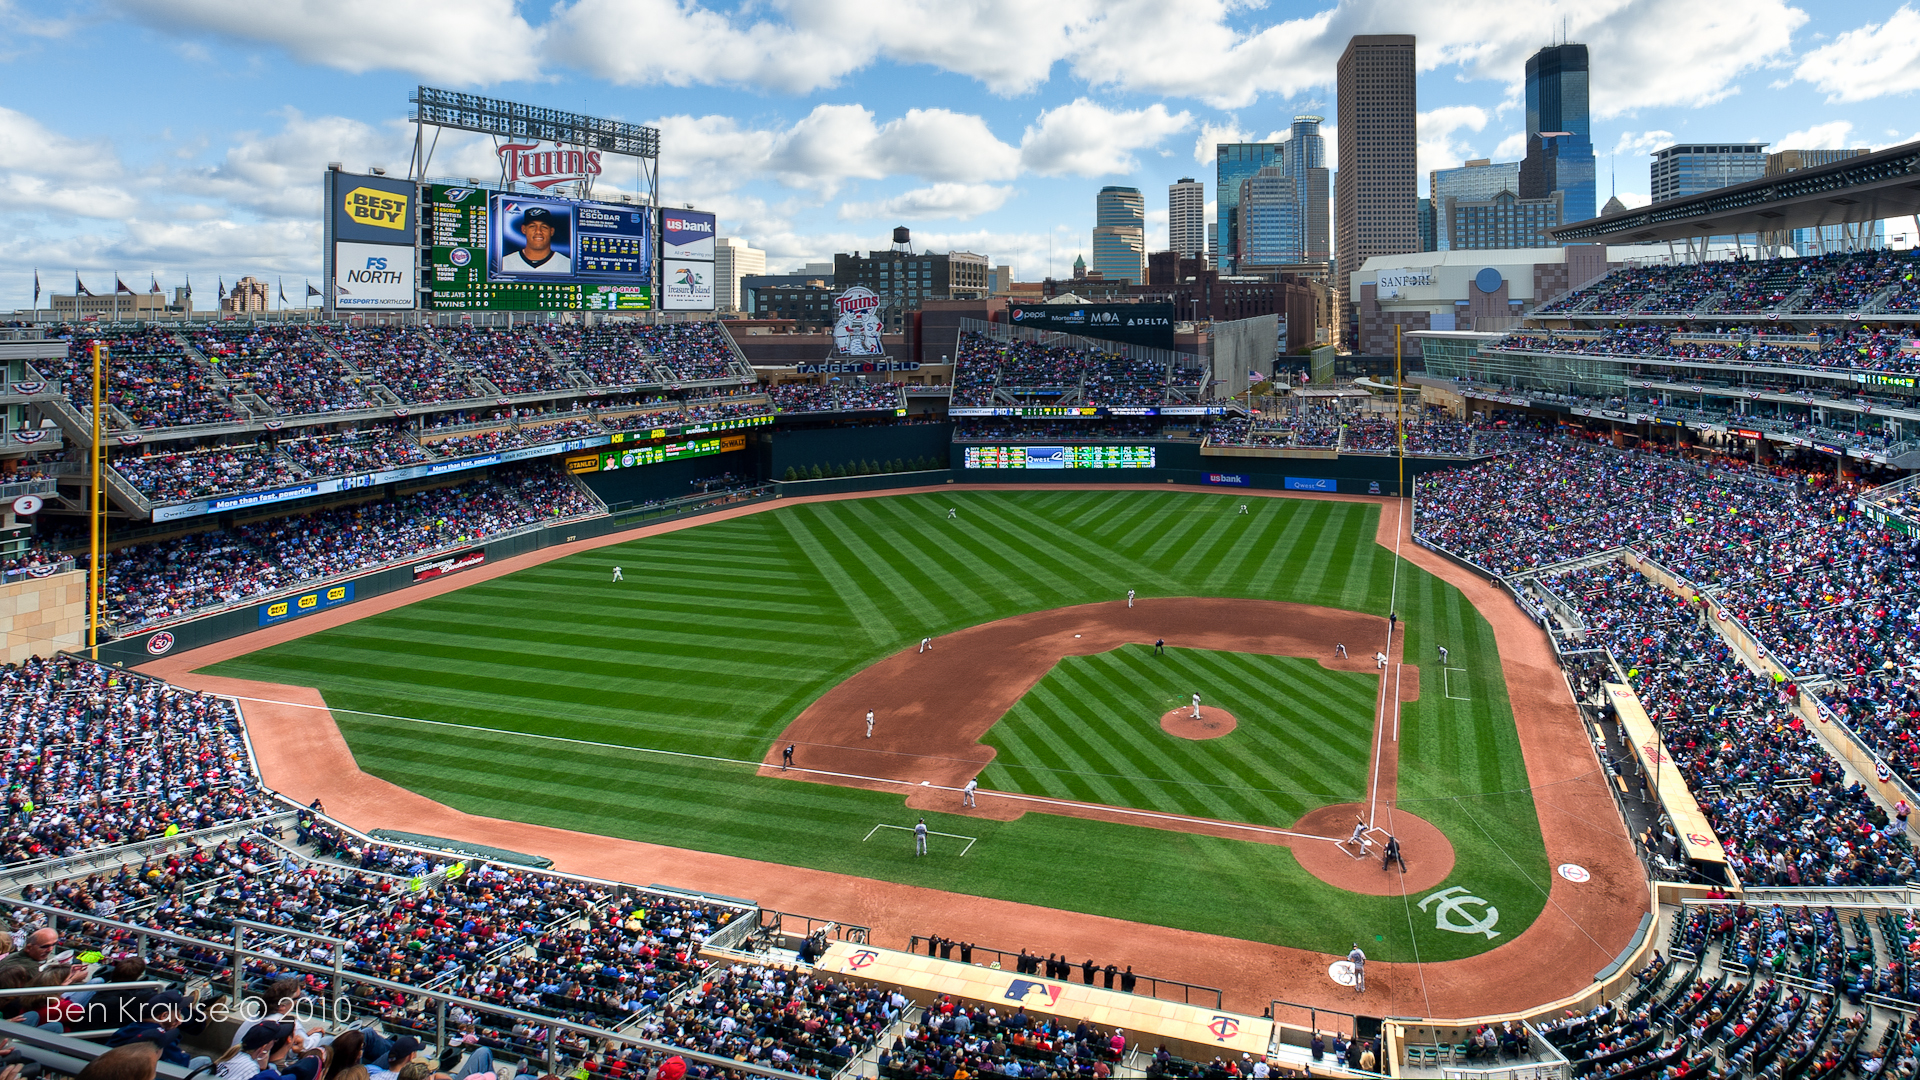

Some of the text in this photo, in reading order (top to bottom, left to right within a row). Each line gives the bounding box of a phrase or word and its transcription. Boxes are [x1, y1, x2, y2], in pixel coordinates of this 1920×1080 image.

[497, 141, 602, 185] Twins
[353, 193, 405, 212] BEST
[354, 205, 400, 223] BUY
[580, 213, 640, 224] ESCOBAR 5
[666, 220, 712, 232] usbank
[366, 257, 388, 270] FS
[347, 270, 402, 284] NORTH
[667, 285, 689, 293] Treasure
[835, 294, 878, 314] Twins
[1024, 311, 1046, 319] pepsi
[228, 321, 250, 329] Porch
[798, 362, 920, 374] TARGET FIELD
[570, 442, 578, 450] HD
[517, 447, 556, 458] HDINTERNET.com
[474, 456, 496, 466] powerful
[569, 460, 596, 469] STANLEY
[349, 476, 365, 488] HD
[1210, 473, 1242, 483] usbank
[216, 500, 238, 509] More
[239, 496, 258, 505] than
[258, 493, 277, 503] fast,
[279, 487, 312, 499] powerful
[23, 501, 32, 509] 3
[439, 556, 484, 573] Budweiser
[155, 639, 167, 647] 50
